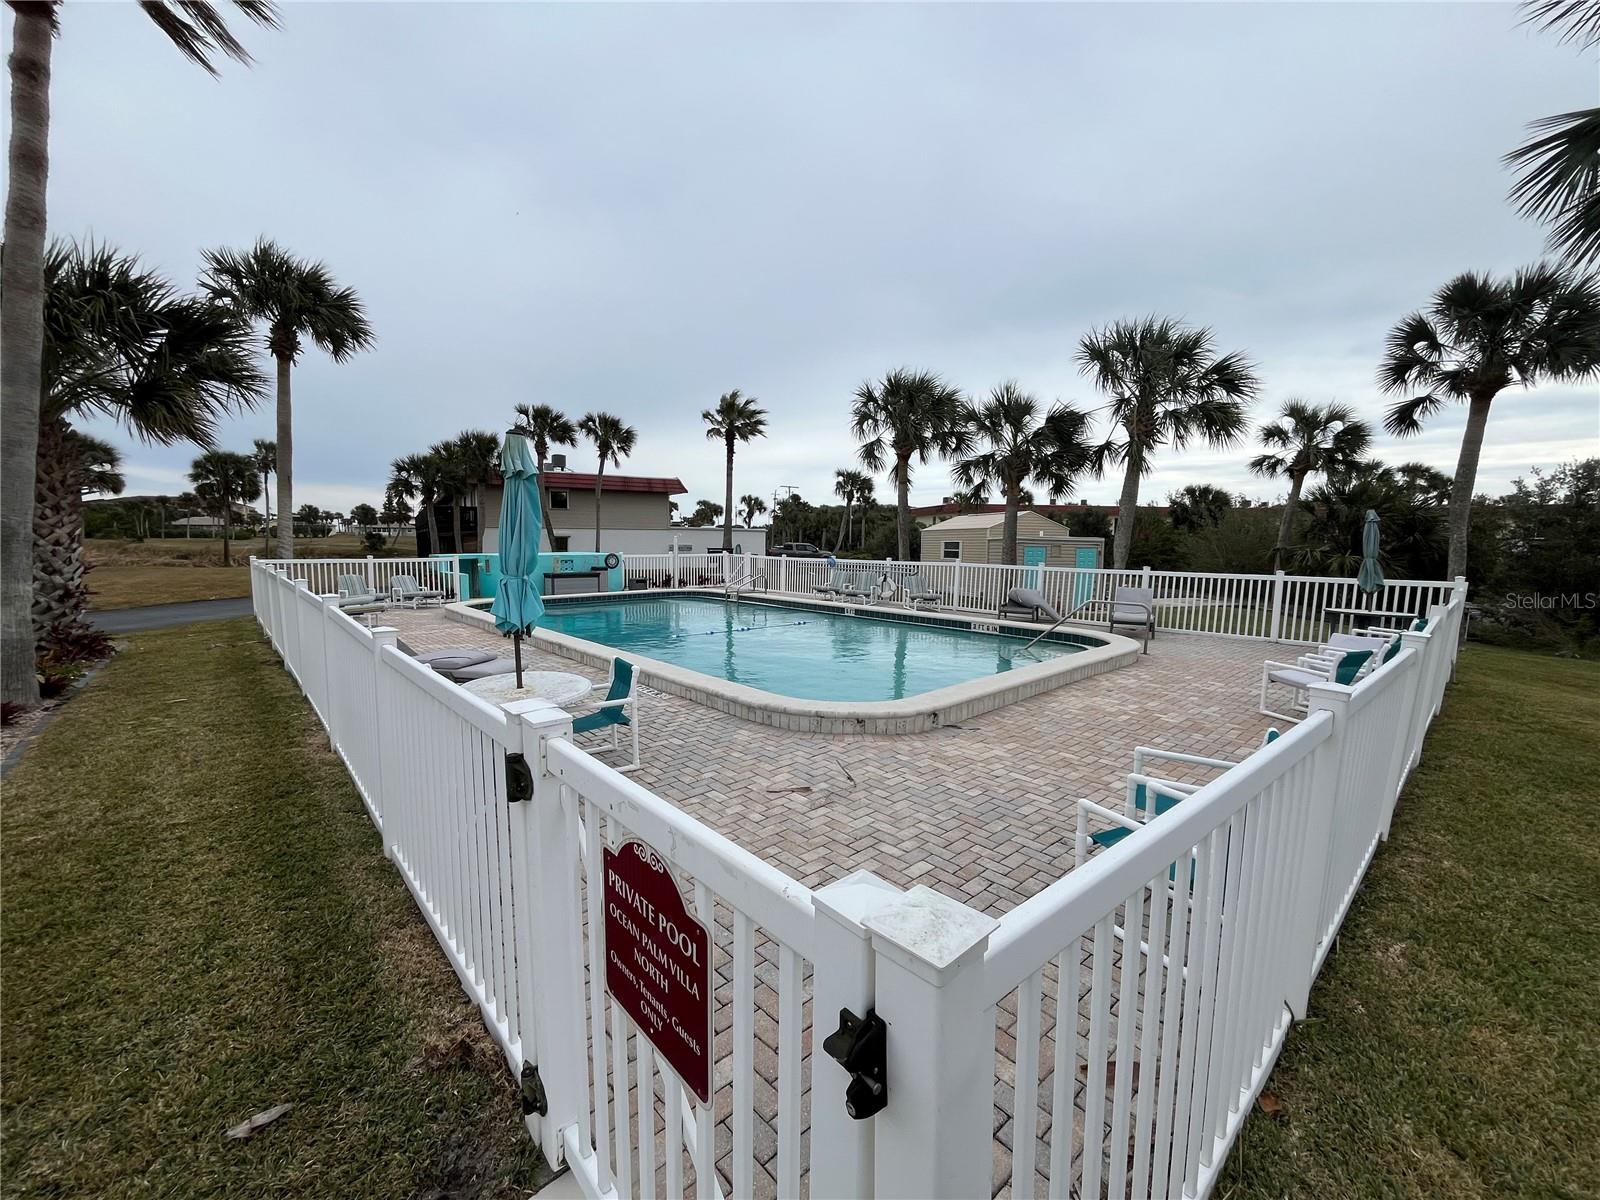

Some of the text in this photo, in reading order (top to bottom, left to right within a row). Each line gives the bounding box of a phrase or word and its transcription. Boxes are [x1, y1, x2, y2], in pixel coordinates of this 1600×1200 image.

[608, 869, 700, 968] PRIVATE POOL
[609, 903, 700, 1001] OCEAN PALM VILLA
[610, 950, 701, 1056] Owners, Tenants, Guests
[634, 947, 669, 994] NORTH
[640, 1000, 663, 1032] ONLY
